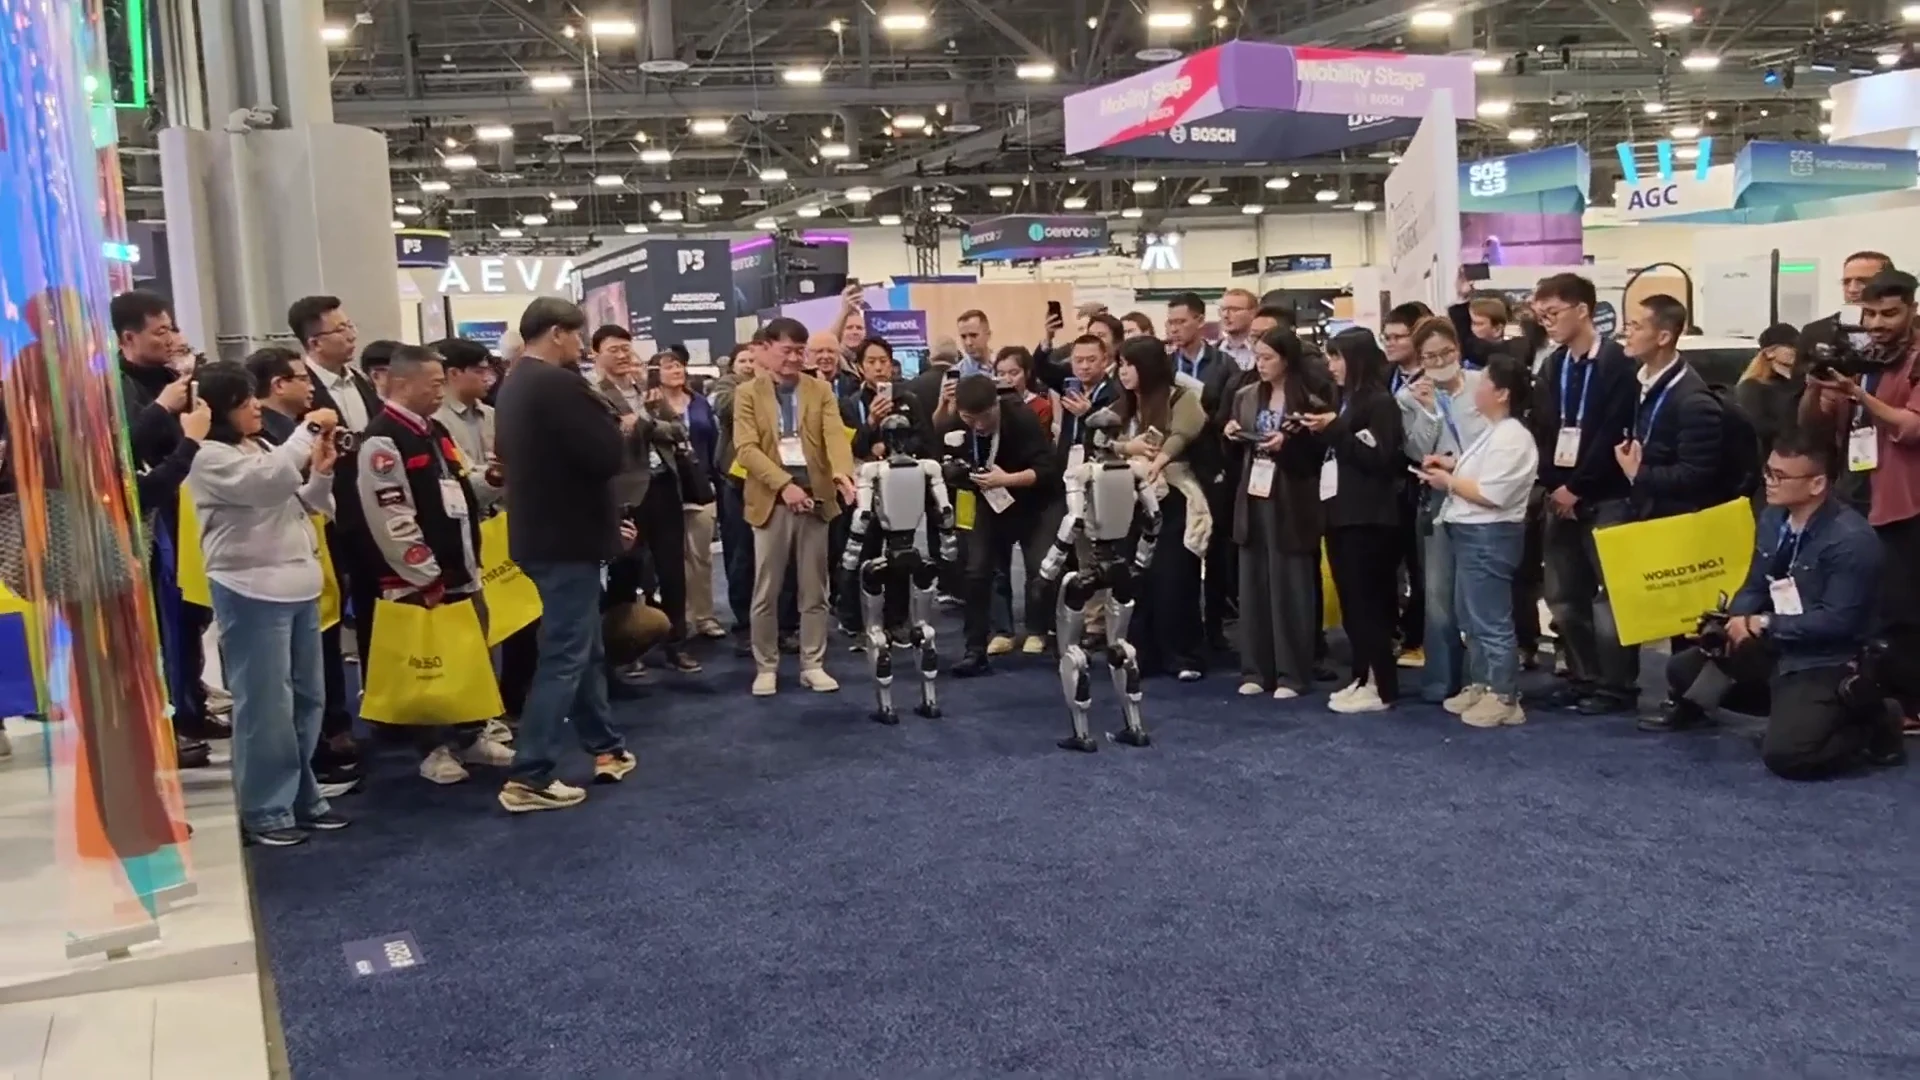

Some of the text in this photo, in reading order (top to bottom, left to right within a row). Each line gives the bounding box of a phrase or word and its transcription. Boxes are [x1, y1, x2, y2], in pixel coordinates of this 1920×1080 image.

[1297, 61, 1426, 91] Mobility Stage
[1100, 75, 1192, 116] Mobility Stage
[1369, 93, 1404, 107] BOSCH
[1190, 126, 1236, 143] BOSCH
[1790, 150, 1814, 163] SOS
[1469, 160, 1507, 181] SOS
[1628, 184, 1679, 210] AGC
[1044, 227, 1089, 238] cerence
[403, 239, 422, 254] P3
[677, 249, 705, 274] P3
[438, 259, 576, 292] AEVA
[1643, 557, 1725, 581] WORLD'S NO.1
